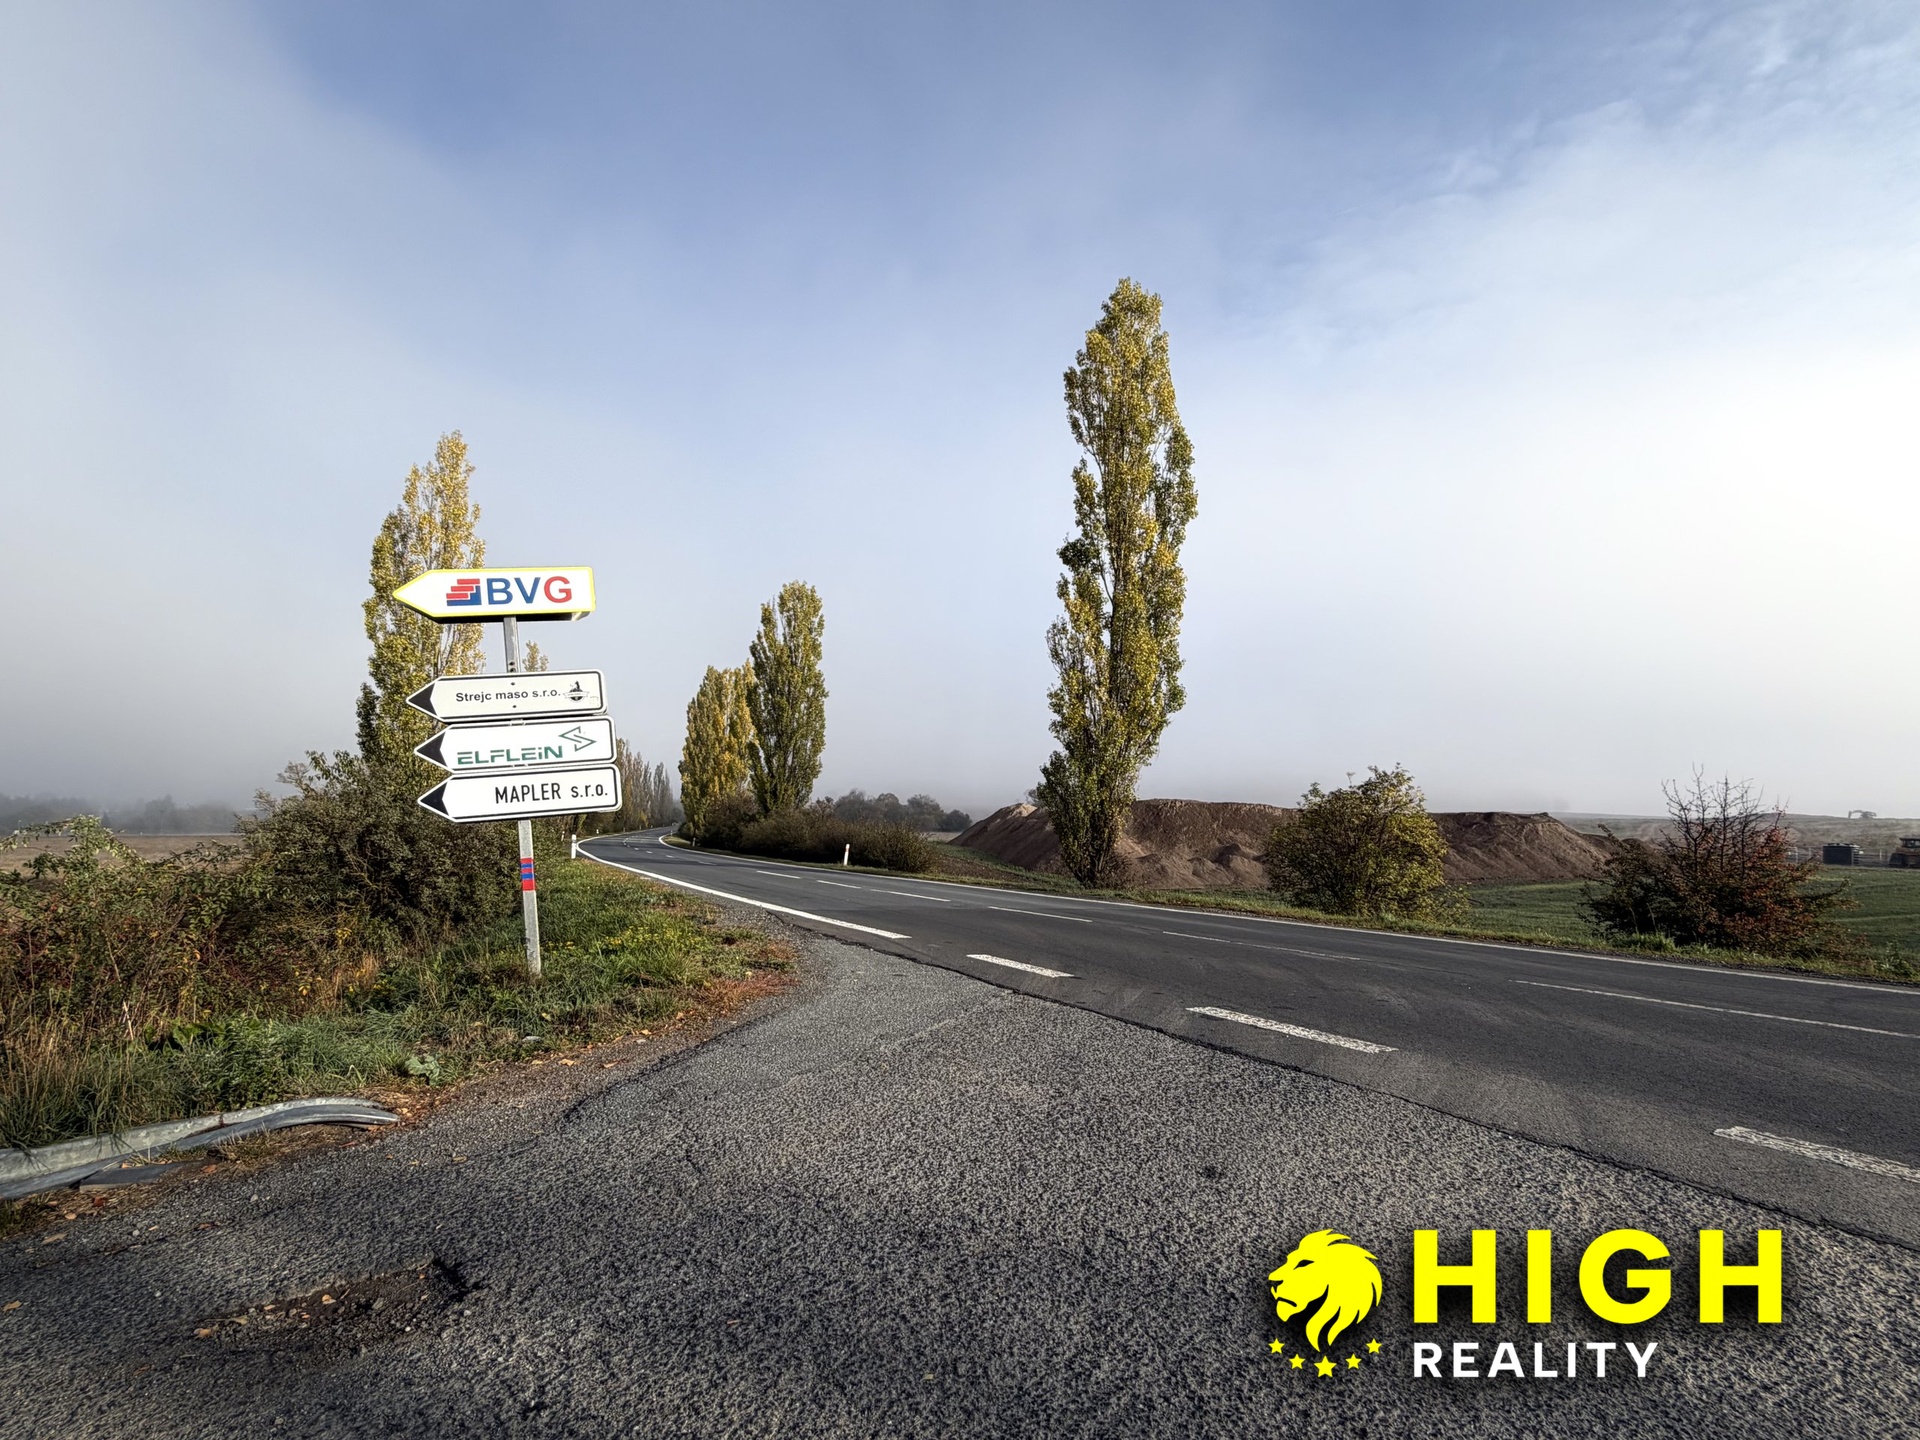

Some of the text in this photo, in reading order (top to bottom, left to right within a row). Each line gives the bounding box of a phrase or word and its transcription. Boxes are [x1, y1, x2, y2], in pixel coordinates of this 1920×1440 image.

[486, 576, 572, 605] BVG
[455, 692, 492, 703] Strejc
[495, 691, 529, 700] maso
[532, 688, 561, 698] s.r.o.
[495, 782, 608, 804] MAPLER s.r.o.
